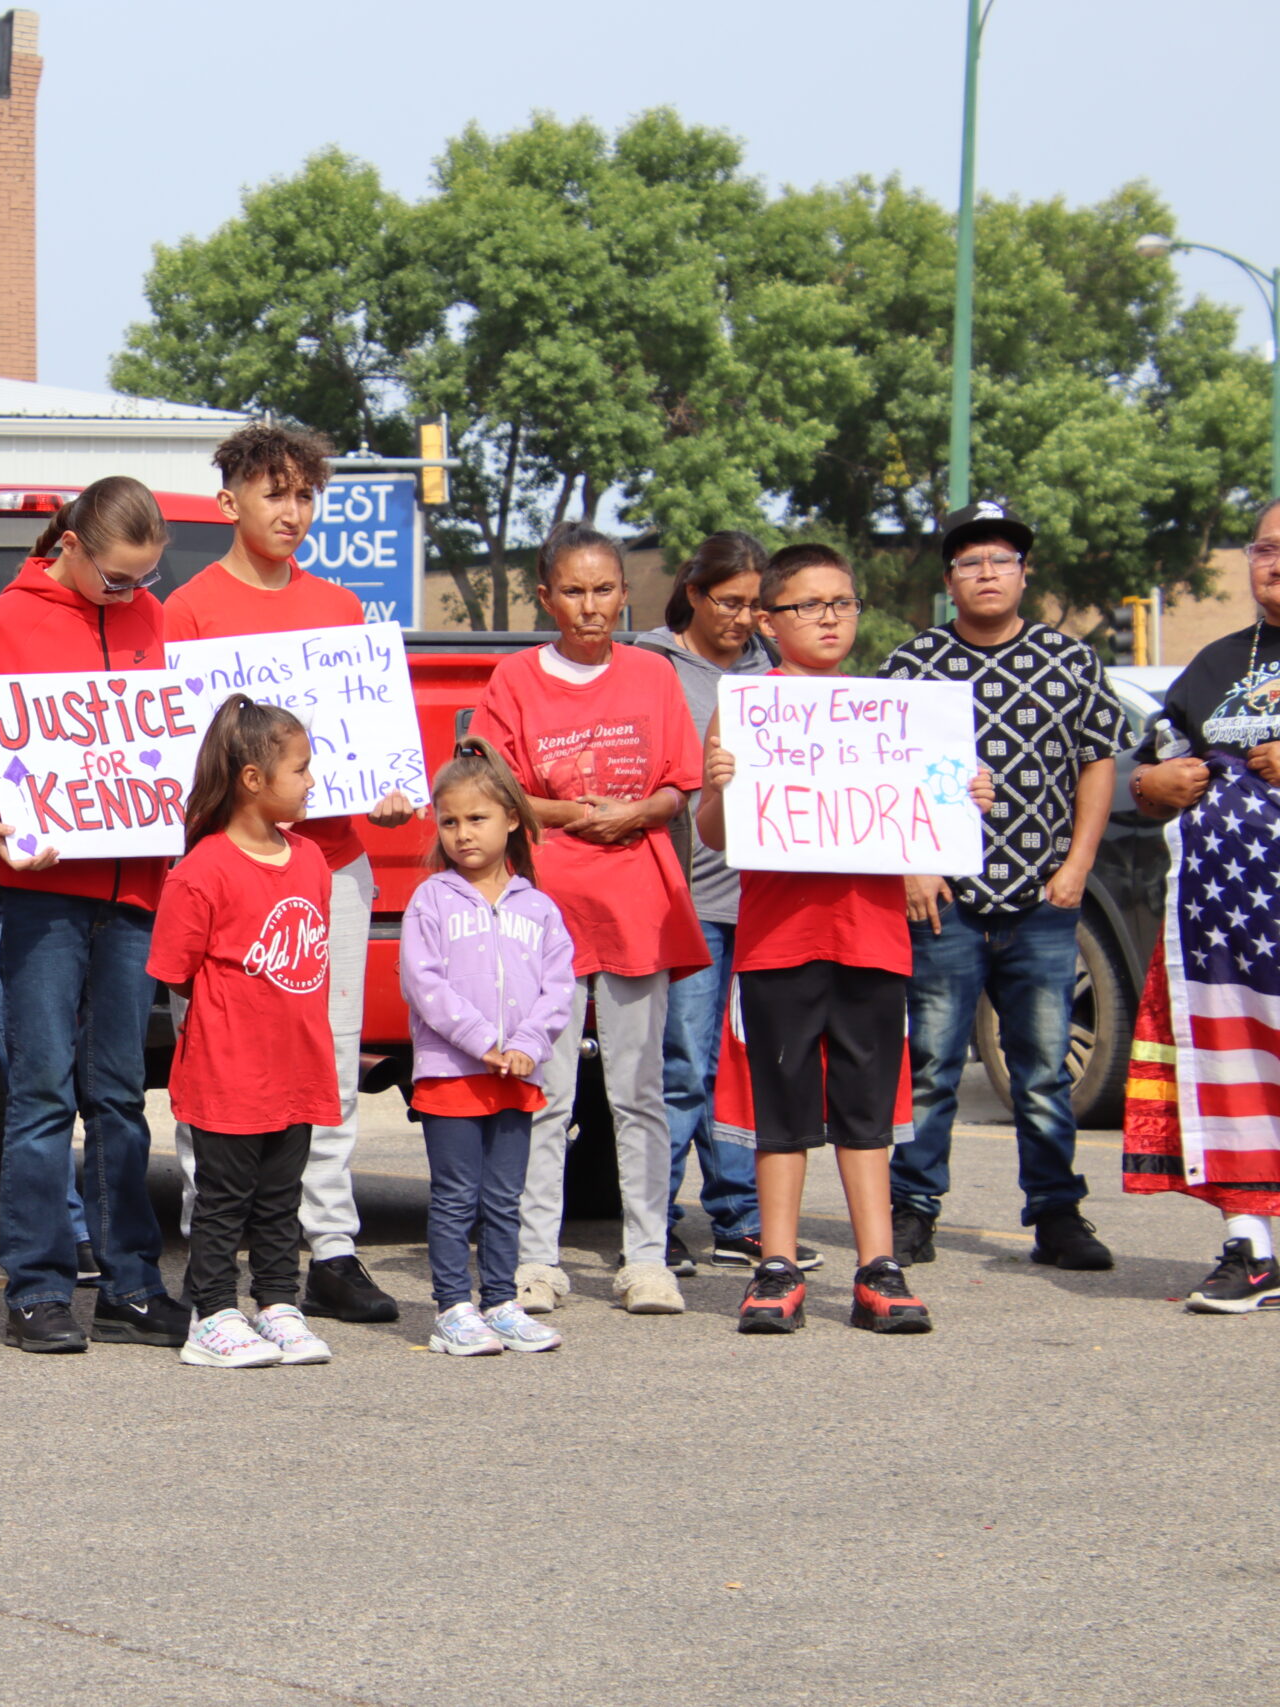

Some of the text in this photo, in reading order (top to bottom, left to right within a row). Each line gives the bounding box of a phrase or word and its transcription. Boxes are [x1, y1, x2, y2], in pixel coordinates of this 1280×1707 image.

[302, 634, 392, 673] Family
[337, 674, 392, 704] the
[730, 685, 909, 740] Today Every
[537, 724, 634, 753] Kendra Owen
[750, 728, 924, 776] Step is for
[25, 771, 186, 834] KENDR
[755, 781, 942, 864] KENDRA
[243, 926, 290, 976] Old
[448, 906, 544, 952] OLD NAVY
